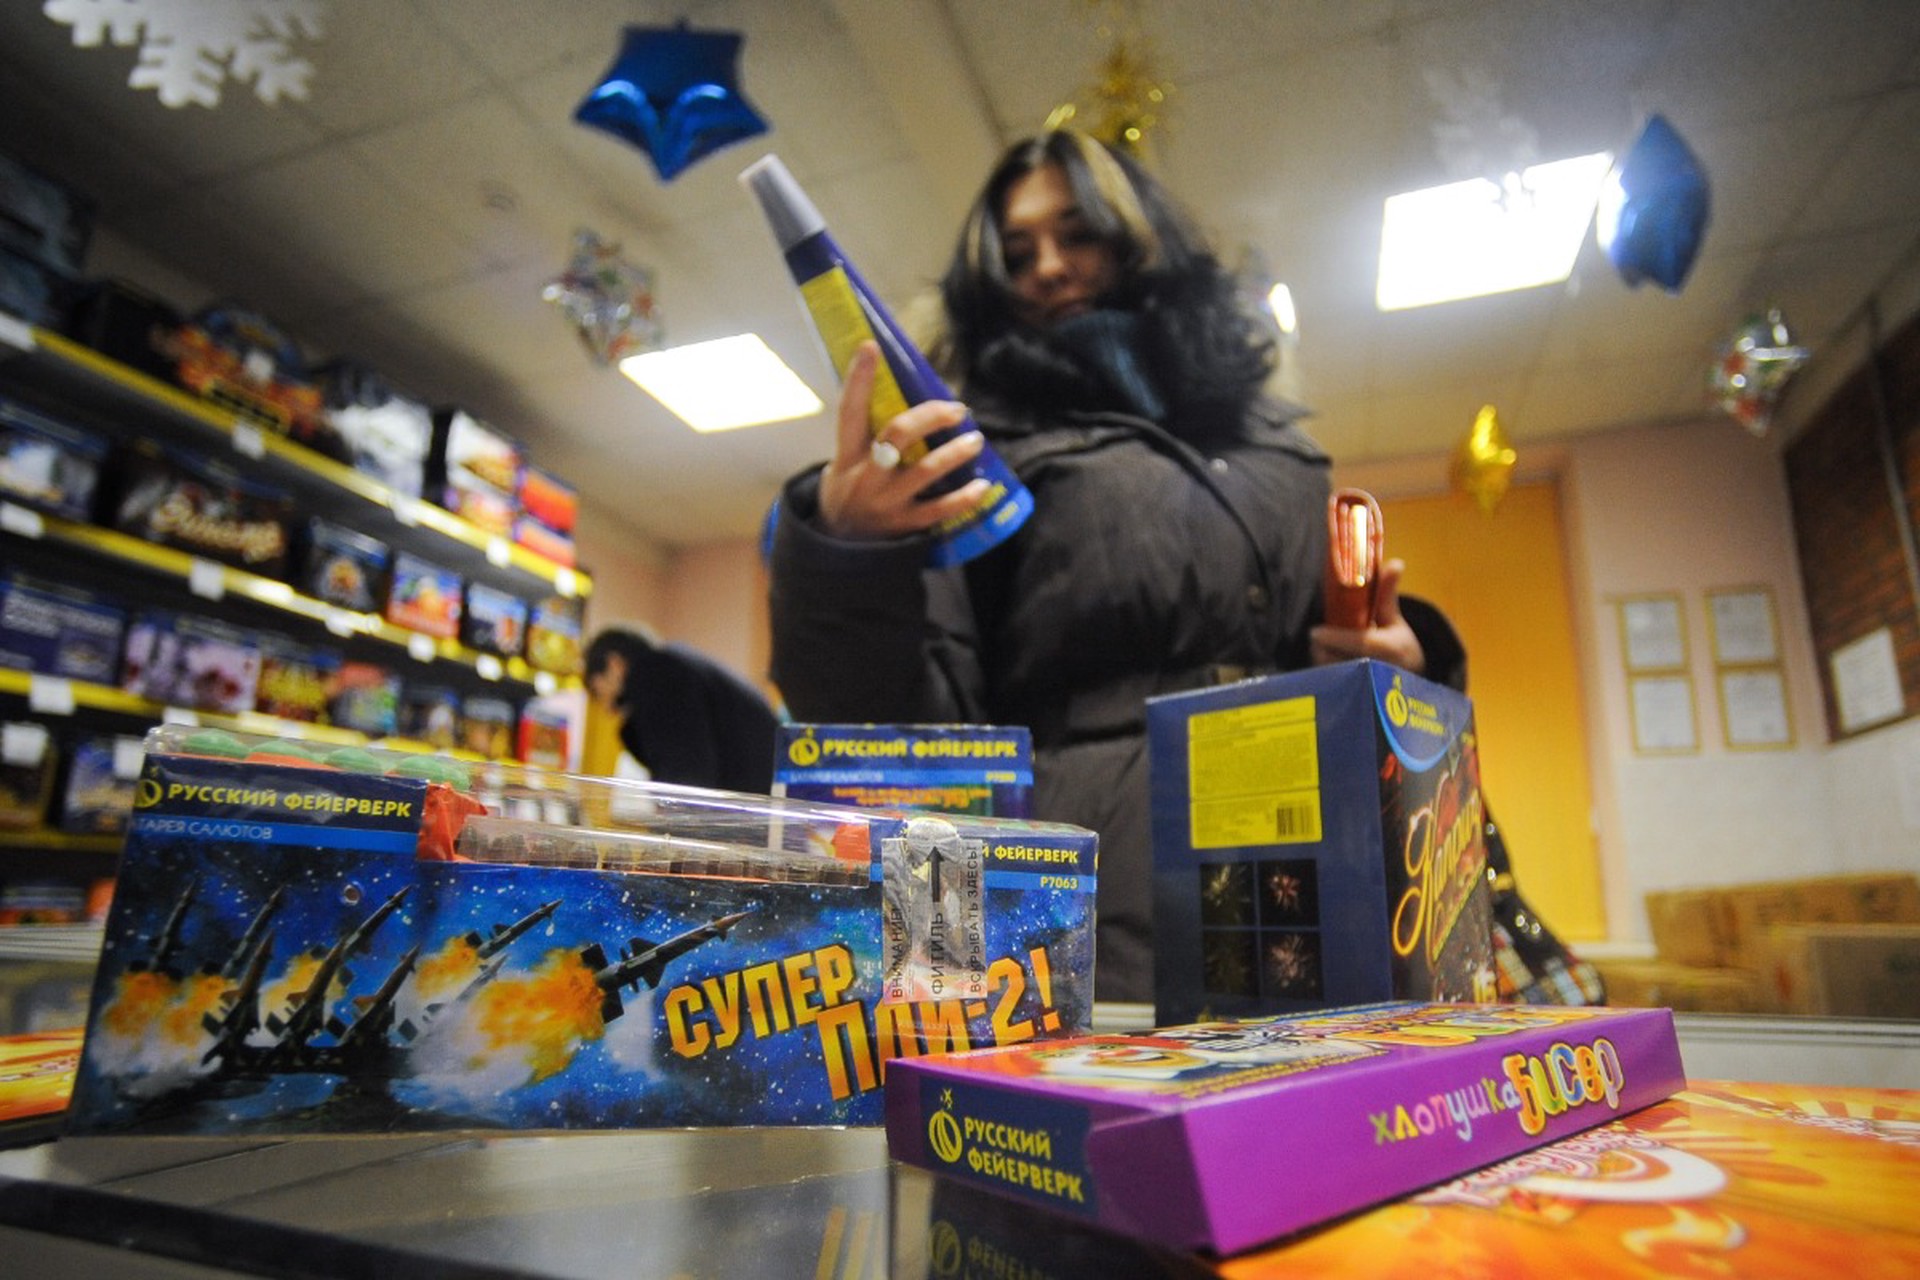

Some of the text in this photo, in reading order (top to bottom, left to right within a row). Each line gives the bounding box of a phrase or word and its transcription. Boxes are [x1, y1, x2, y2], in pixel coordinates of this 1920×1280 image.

[168, 783, 412, 818] РУССКИЙ ФЕЙЕРВЕРК
[134, 817, 273, 840] ТАРЕЯ САЛЮТОВ
[994, 844, 1079, 864] ФЕЙЕРВЕРК
[930, 912, 945, 994] ФИТИЛЬ
[968, 902, 982, 993] ВСКРЫВАТЬ
[664, 944, 855, 1059] СУПЕР
[964, 1116, 1052, 1161] РУССКИЙ
[967, 1147, 1085, 1203] ФЕЙЕРВЕРК
